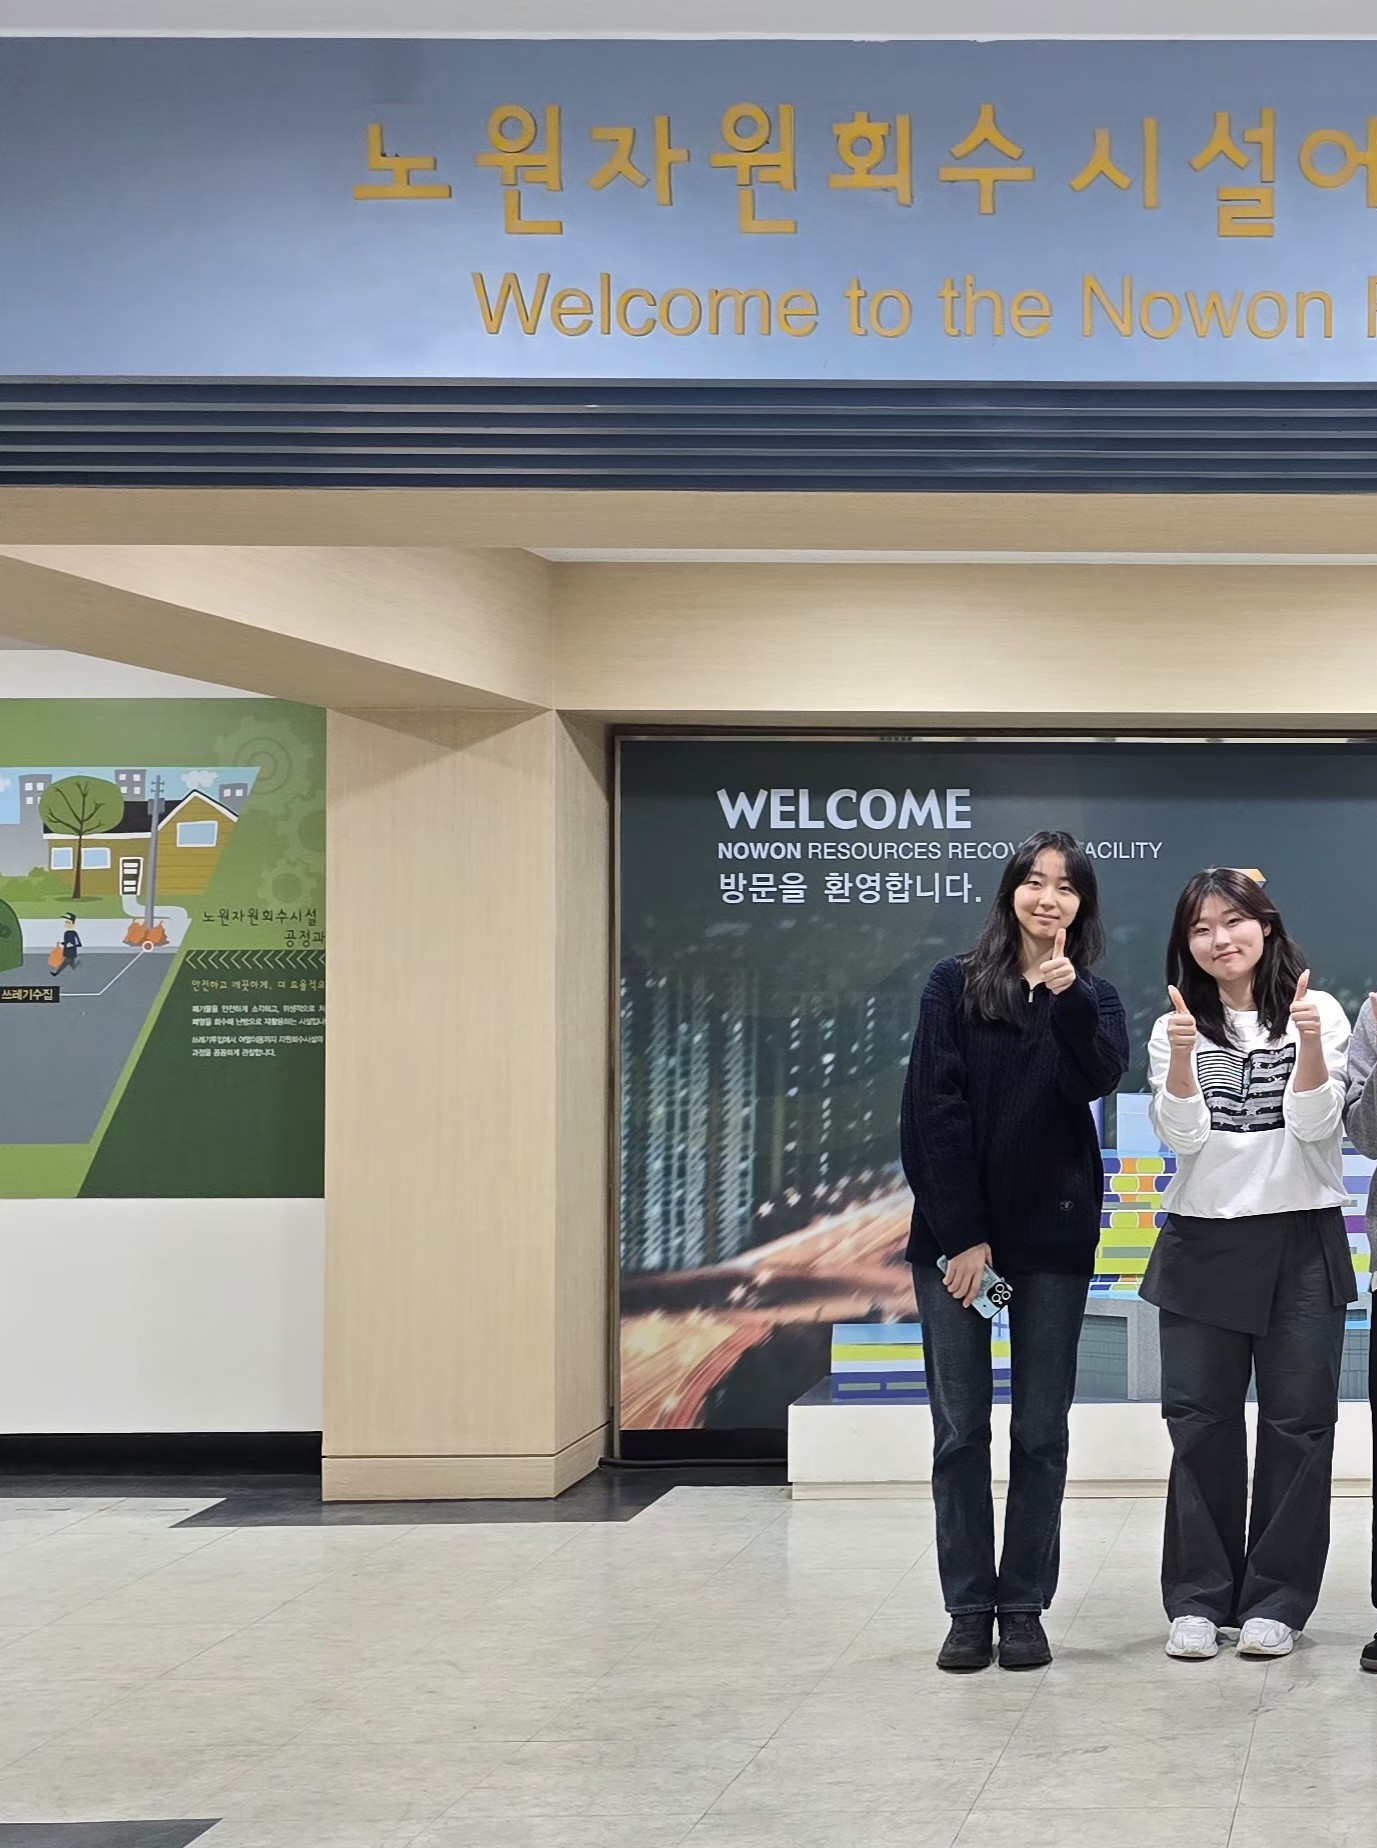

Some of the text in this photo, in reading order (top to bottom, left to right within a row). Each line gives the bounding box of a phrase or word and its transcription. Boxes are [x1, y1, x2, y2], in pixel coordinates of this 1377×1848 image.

[473, 272, 817, 337] Welcome
[848, 279, 911, 337] to
[938, 274, 1053, 337] the
[1082, 275, 1334, 339] Nowon
[716, 788, 972, 830] WELCOME
[718, 840, 1163, 860] NOWON RESOURCES RECOV ACILITY
[719, 872, 983, 905] 방문을 환영합니다.
[202, 907, 317, 927] 노원자원회수시설
[1, 988, 54, 1001] 쓰레기수집
